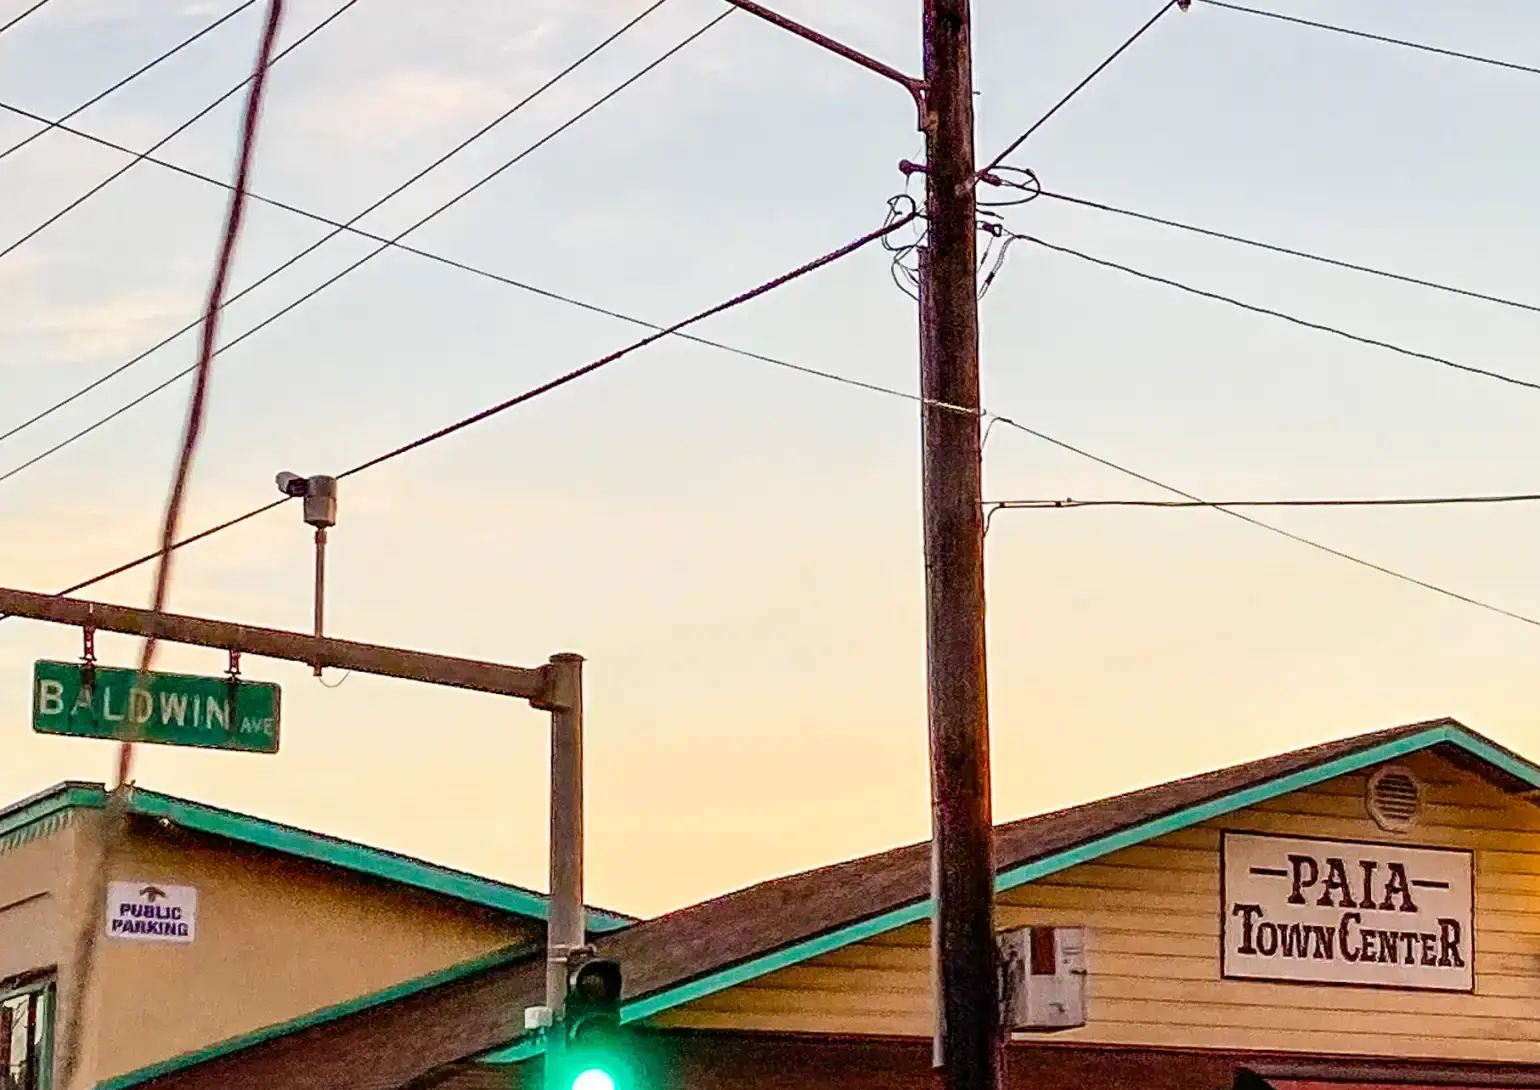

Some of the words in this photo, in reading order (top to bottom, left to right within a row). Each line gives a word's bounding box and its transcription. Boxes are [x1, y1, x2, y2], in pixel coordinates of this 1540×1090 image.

[39, 679, 231, 731] BALDWIN
[239, 716, 274, 736] AVE
[1287, 854, 1418, 912] PAIA
[111, 919, 189, 937] PARKING
[120, 903, 182, 920] PUBLIC
